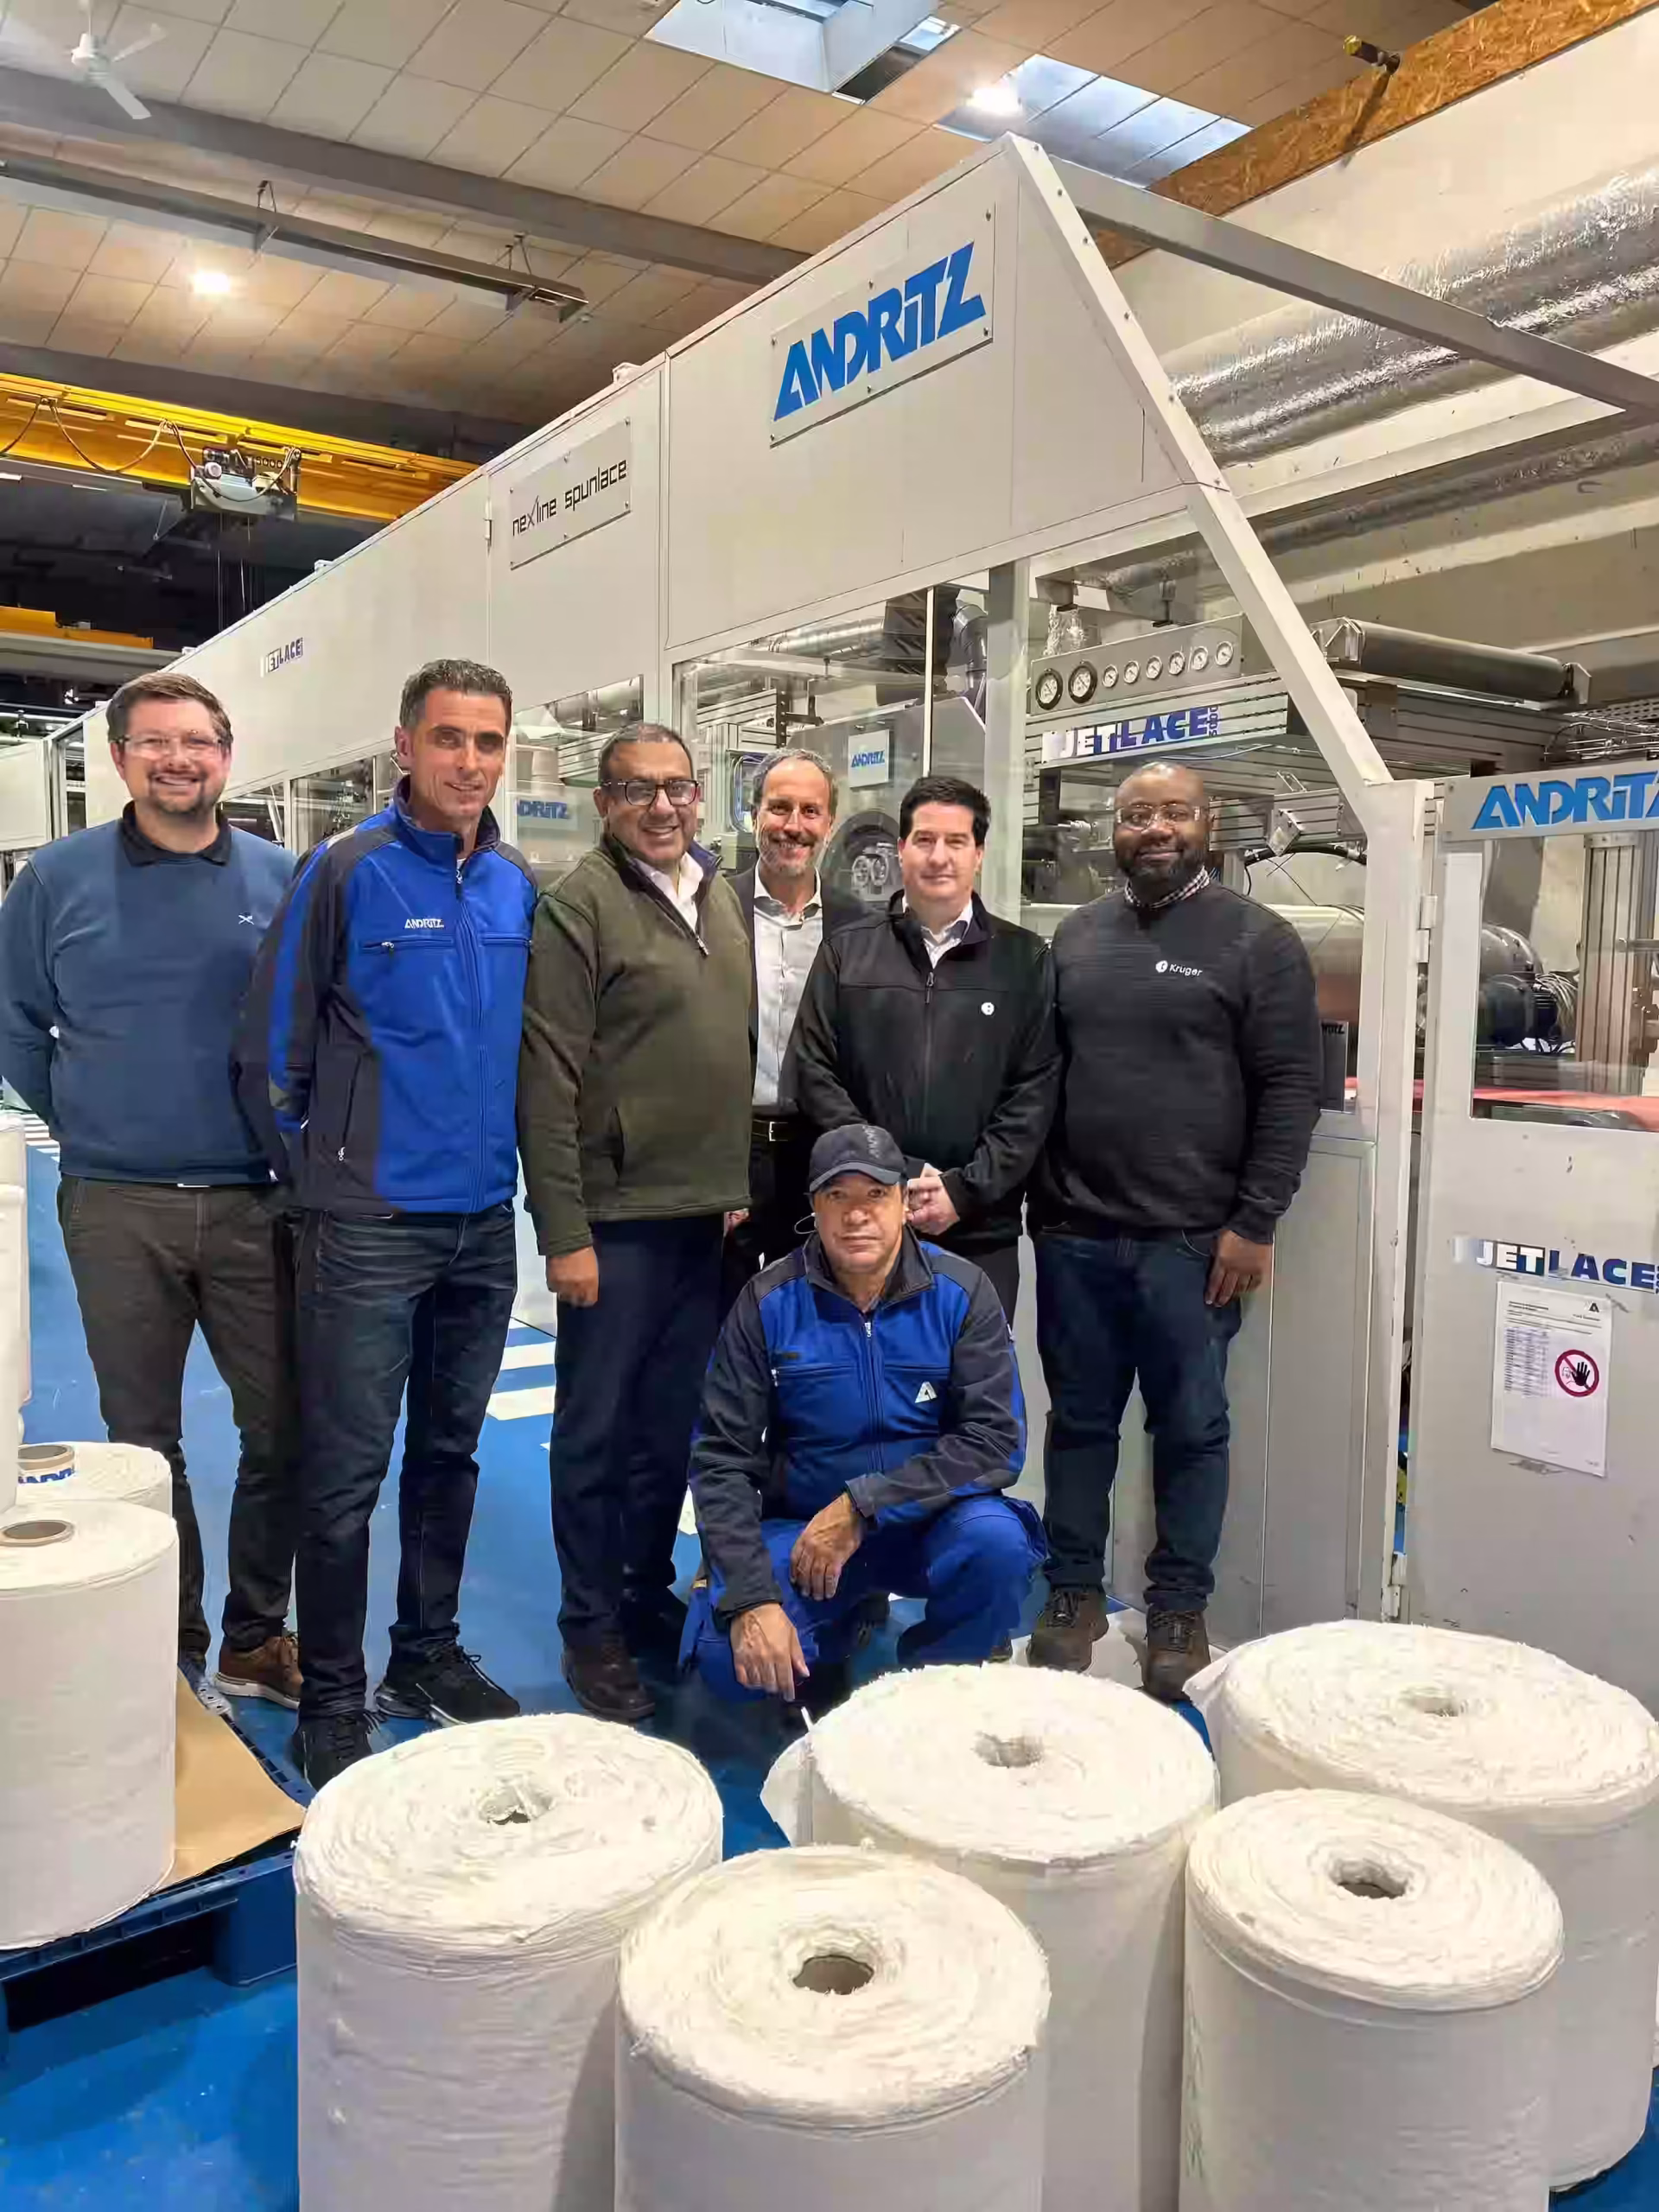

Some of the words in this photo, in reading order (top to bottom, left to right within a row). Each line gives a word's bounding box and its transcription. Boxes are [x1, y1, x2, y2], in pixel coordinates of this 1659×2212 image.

[564, 460, 626, 512] spunlace
[1059, 706, 1208, 759] JETLACE
[1169, 963, 1203, 976] Kruger
[1476, 1240, 1656, 1290] JETLACE
